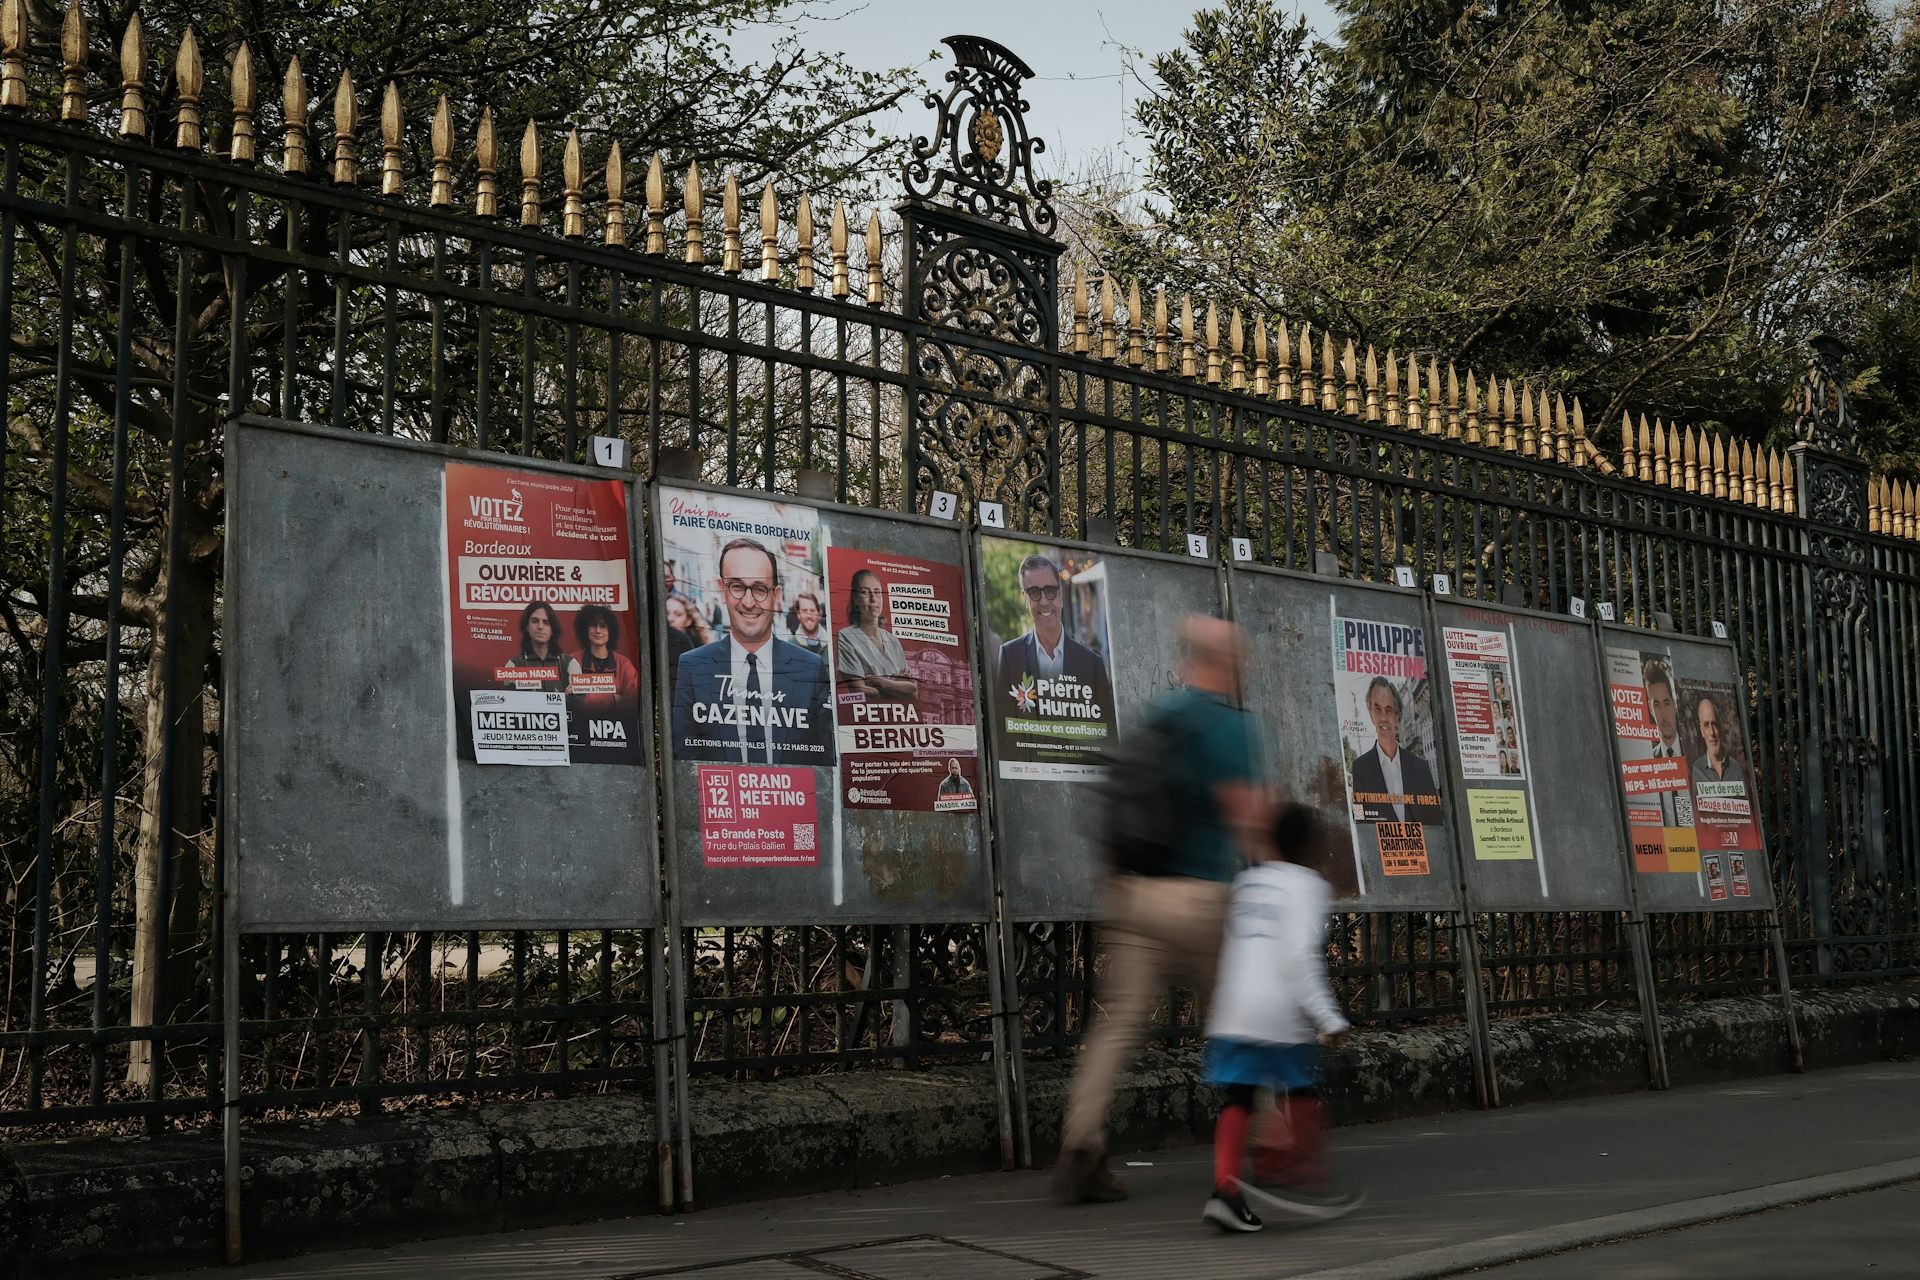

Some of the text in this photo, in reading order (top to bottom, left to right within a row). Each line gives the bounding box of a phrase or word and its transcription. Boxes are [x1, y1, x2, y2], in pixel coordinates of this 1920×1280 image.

[605, 443, 612, 460] 1
[507, 478, 530, 486] Élections
[530, 482, 559, 491] municipales
[469, 496, 524, 522] VOTEZ
[556, 503, 596, 516] Pour que les
[938, 497, 947, 512] 3
[556, 514, 593, 523] travailleurs
[704, 508, 731, 521] pour
[988, 509, 996, 523] 4
[464, 519, 527, 533] RÉVOLUTIONNAIRES
[564, 522, 573, 530] les
[575, 523, 616, 532] travailleuses
[673, 515, 811, 542] FAIRE GAGNER BORDEAUX
[556, 530, 588, 540] décident
[465, 540, 531, 556] Bordeaux
[1194, 540, 1201, 553] 5
[1239, 543, 1246, 556] 6
[479, 561, 582, 581] OUVRIÈRE &
[1402, 572, 1408, 584] 7
[471, 582, 614, 603] RÉVOLUTIONNAIRE
[891, 586, 932, 594] ARRACHER
[1438, 580, 1444, 592] 8
[892, 600, 948, 613] BORDEAUX
[1575, 603, 1581, 614] 9
[1601, 606, 1612, 616] 10
[894, 617, 946, 629] AUX RICHES
[1714, 624, 1723, 634] 11
[914, 632, 956, 643] SPÉCULATEURS
[1344, 621, 1424, 657] PHILIPPE
[1445, 631, 1464, 640] LUTTE
[1447, 640, 1478, 651] OUVRIÈRE
[1478, 663, 1500, 671] PUBLIQUE
[496, 670, 557, 678] Esteban NADAL
[573, 676, 590, 684] Nora
[1059, 674, 1077, 682] Avec
[714, 674, 786, 703] Thomas
[1037, 679, 1092, 700] Pierre
[841, 694, 863, 702] VOTEZ
[1611, 688, 1643, 705] VOTEZ
[692, 702, 810, 729] CAZENAVE
[853, 704, 919, 722] PETRA
[1039, 699, 1101, 719] Hurmic
[1613, 707, 1643, 721] MEDHI
[479, 712, 558, 729] MEETING
[589, 720, 627, 739] NPA
[1008, 720, 1106, 736] Bordeaux en confiance
[1616, 722, 1660, 739] Saboulard
[482, 733, 504, 741] JEUDI
[544, 734, 557, 742] 19H
[590, 739, 627, 747] RÉVOLUTIONNAIRES
[854, 728, 945, 749] BERNUS
[685, 737, 722, 748] ÉLECTIONS
[722, 740, 765, 749] MUNICIPALES
[792, 744, 809, 752] MARS
[1622, 764, 1639, 774] Pour
[1654, 762, 1678, 774] gauche
[707, 773, 791, 789] JEU GRAND
[1625, 778, 1687, 792] Ni PS Ni Extrême
[1698, 784, 1744, 795] Vert de rage
[710, 788, 806, 806] 12 MEETING
[860, 796, 891, 804] Permanente
[1417, 795, 1437, 805] FORCE
[1698, 798, 1749, 812] Rouge de lutte
[708, 808, 759, 819] MAR 19H
[706, 829, 785, 839] La Grande Poste
[1378, 823, 1421, 838] HALLE DES
[707, 842, 711, 850] 7
[728, 842, 736, 850] du
[739, 842, 760, 850] Palais
[761, 842, 785, 850] Gallien
[1381, 839, 1424, 851] CHARTRONS
[1636, 844, 1663, 854] MEDHI
[708, 856, 738, 864] Inscription
